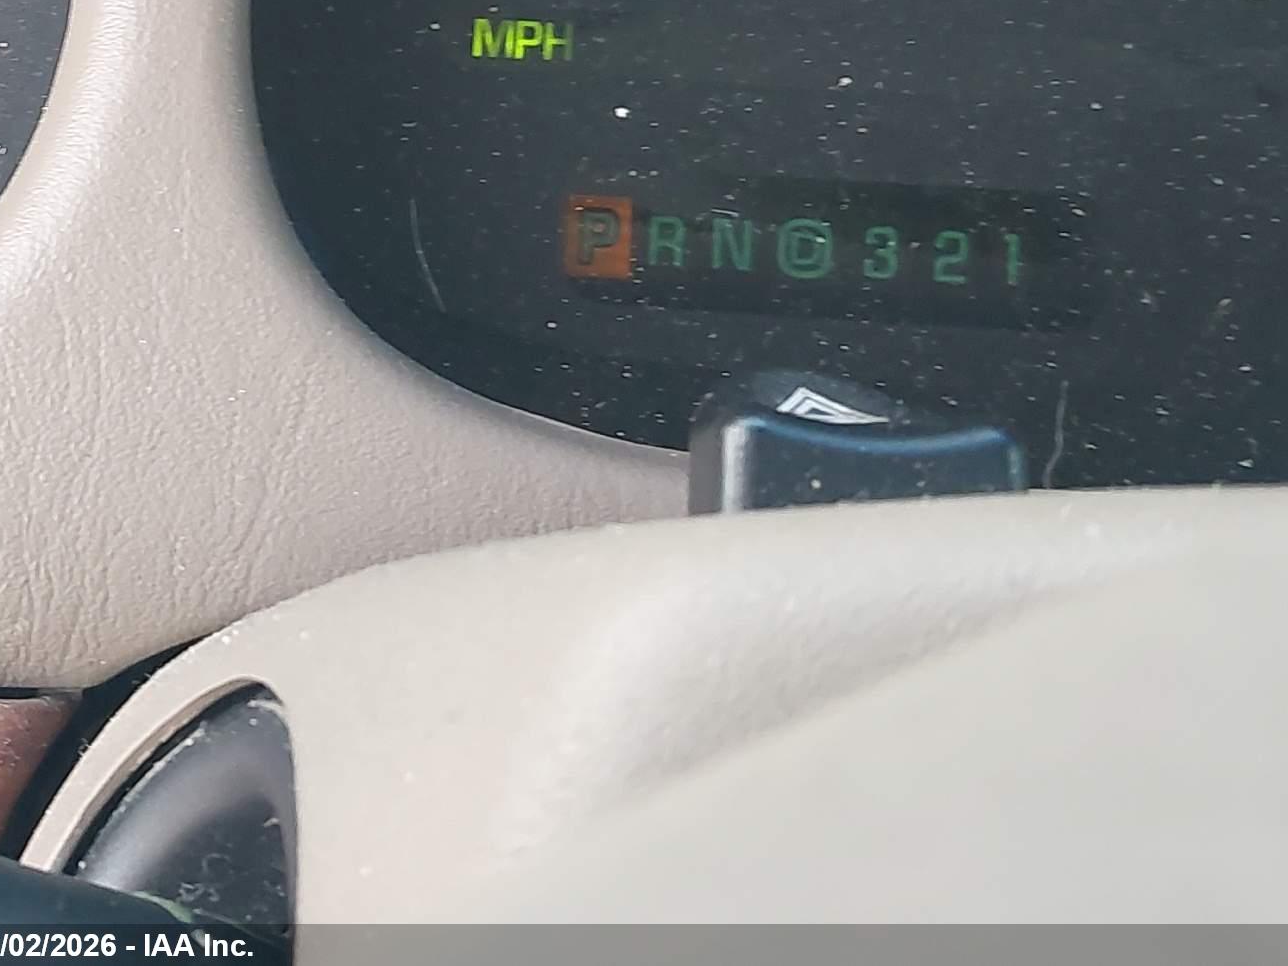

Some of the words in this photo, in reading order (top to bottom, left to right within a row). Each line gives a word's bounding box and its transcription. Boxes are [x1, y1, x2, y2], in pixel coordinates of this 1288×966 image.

[471, 17, 574, 62] MPH
[577, 207, 622, 267] P
[647, 214, 688, 267] R
[712, 218, 755, 272] N
[863, 225, 899, 280] 3
[933, 230, 969, 284] 2
[1003, 232, 1021, 285] 1
